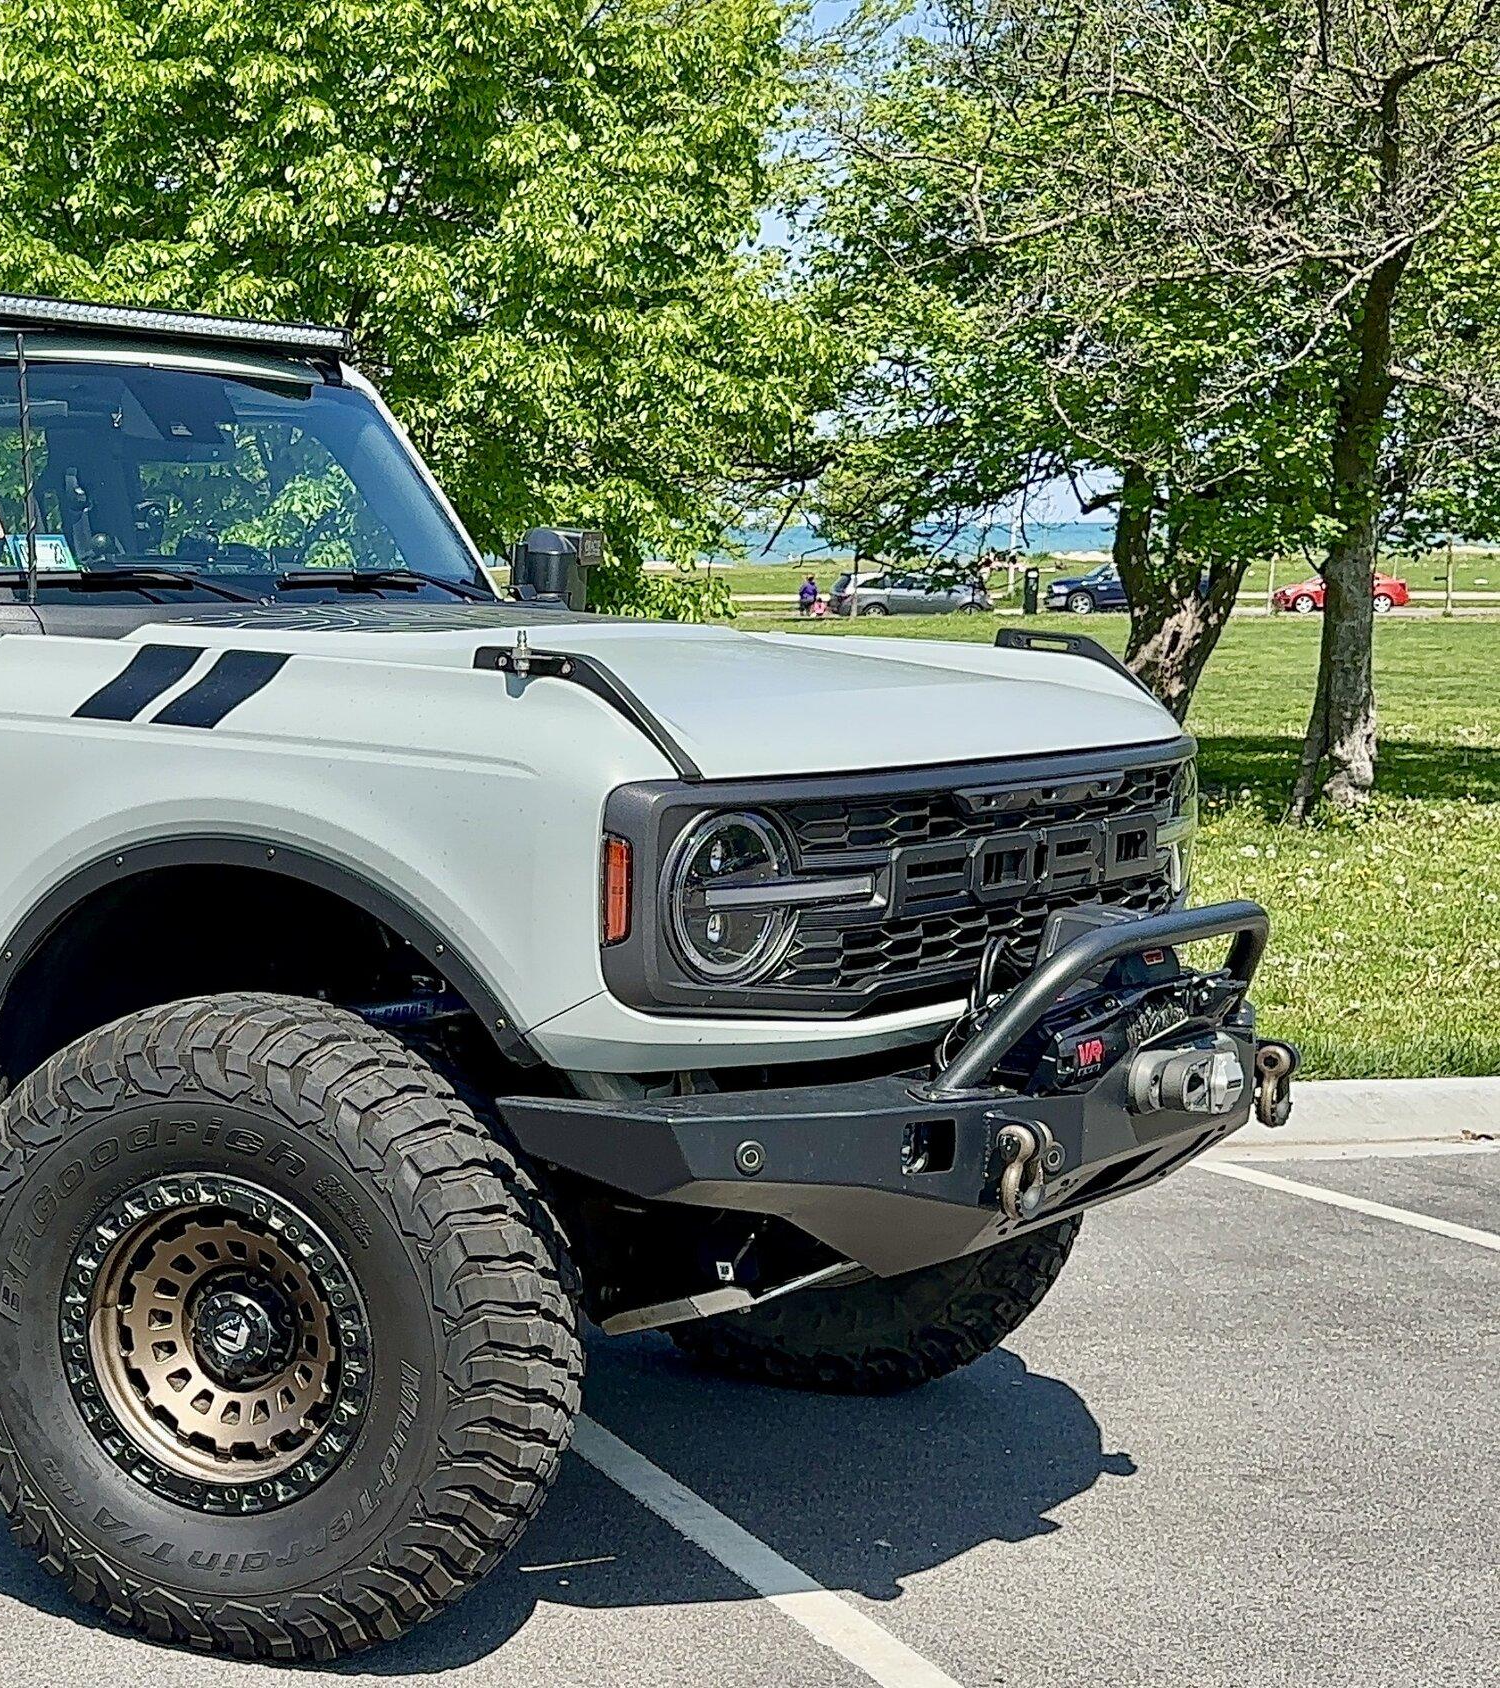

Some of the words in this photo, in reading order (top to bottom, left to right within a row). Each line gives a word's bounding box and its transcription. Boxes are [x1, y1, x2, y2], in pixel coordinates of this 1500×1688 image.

[890, 813, 1158, 917] FORD
[1077, 1039, 1103, 1067] VR
[189, 1359, 422, 1577] Mud-Terrain
[92, 1507, 176, 1567] T/A
